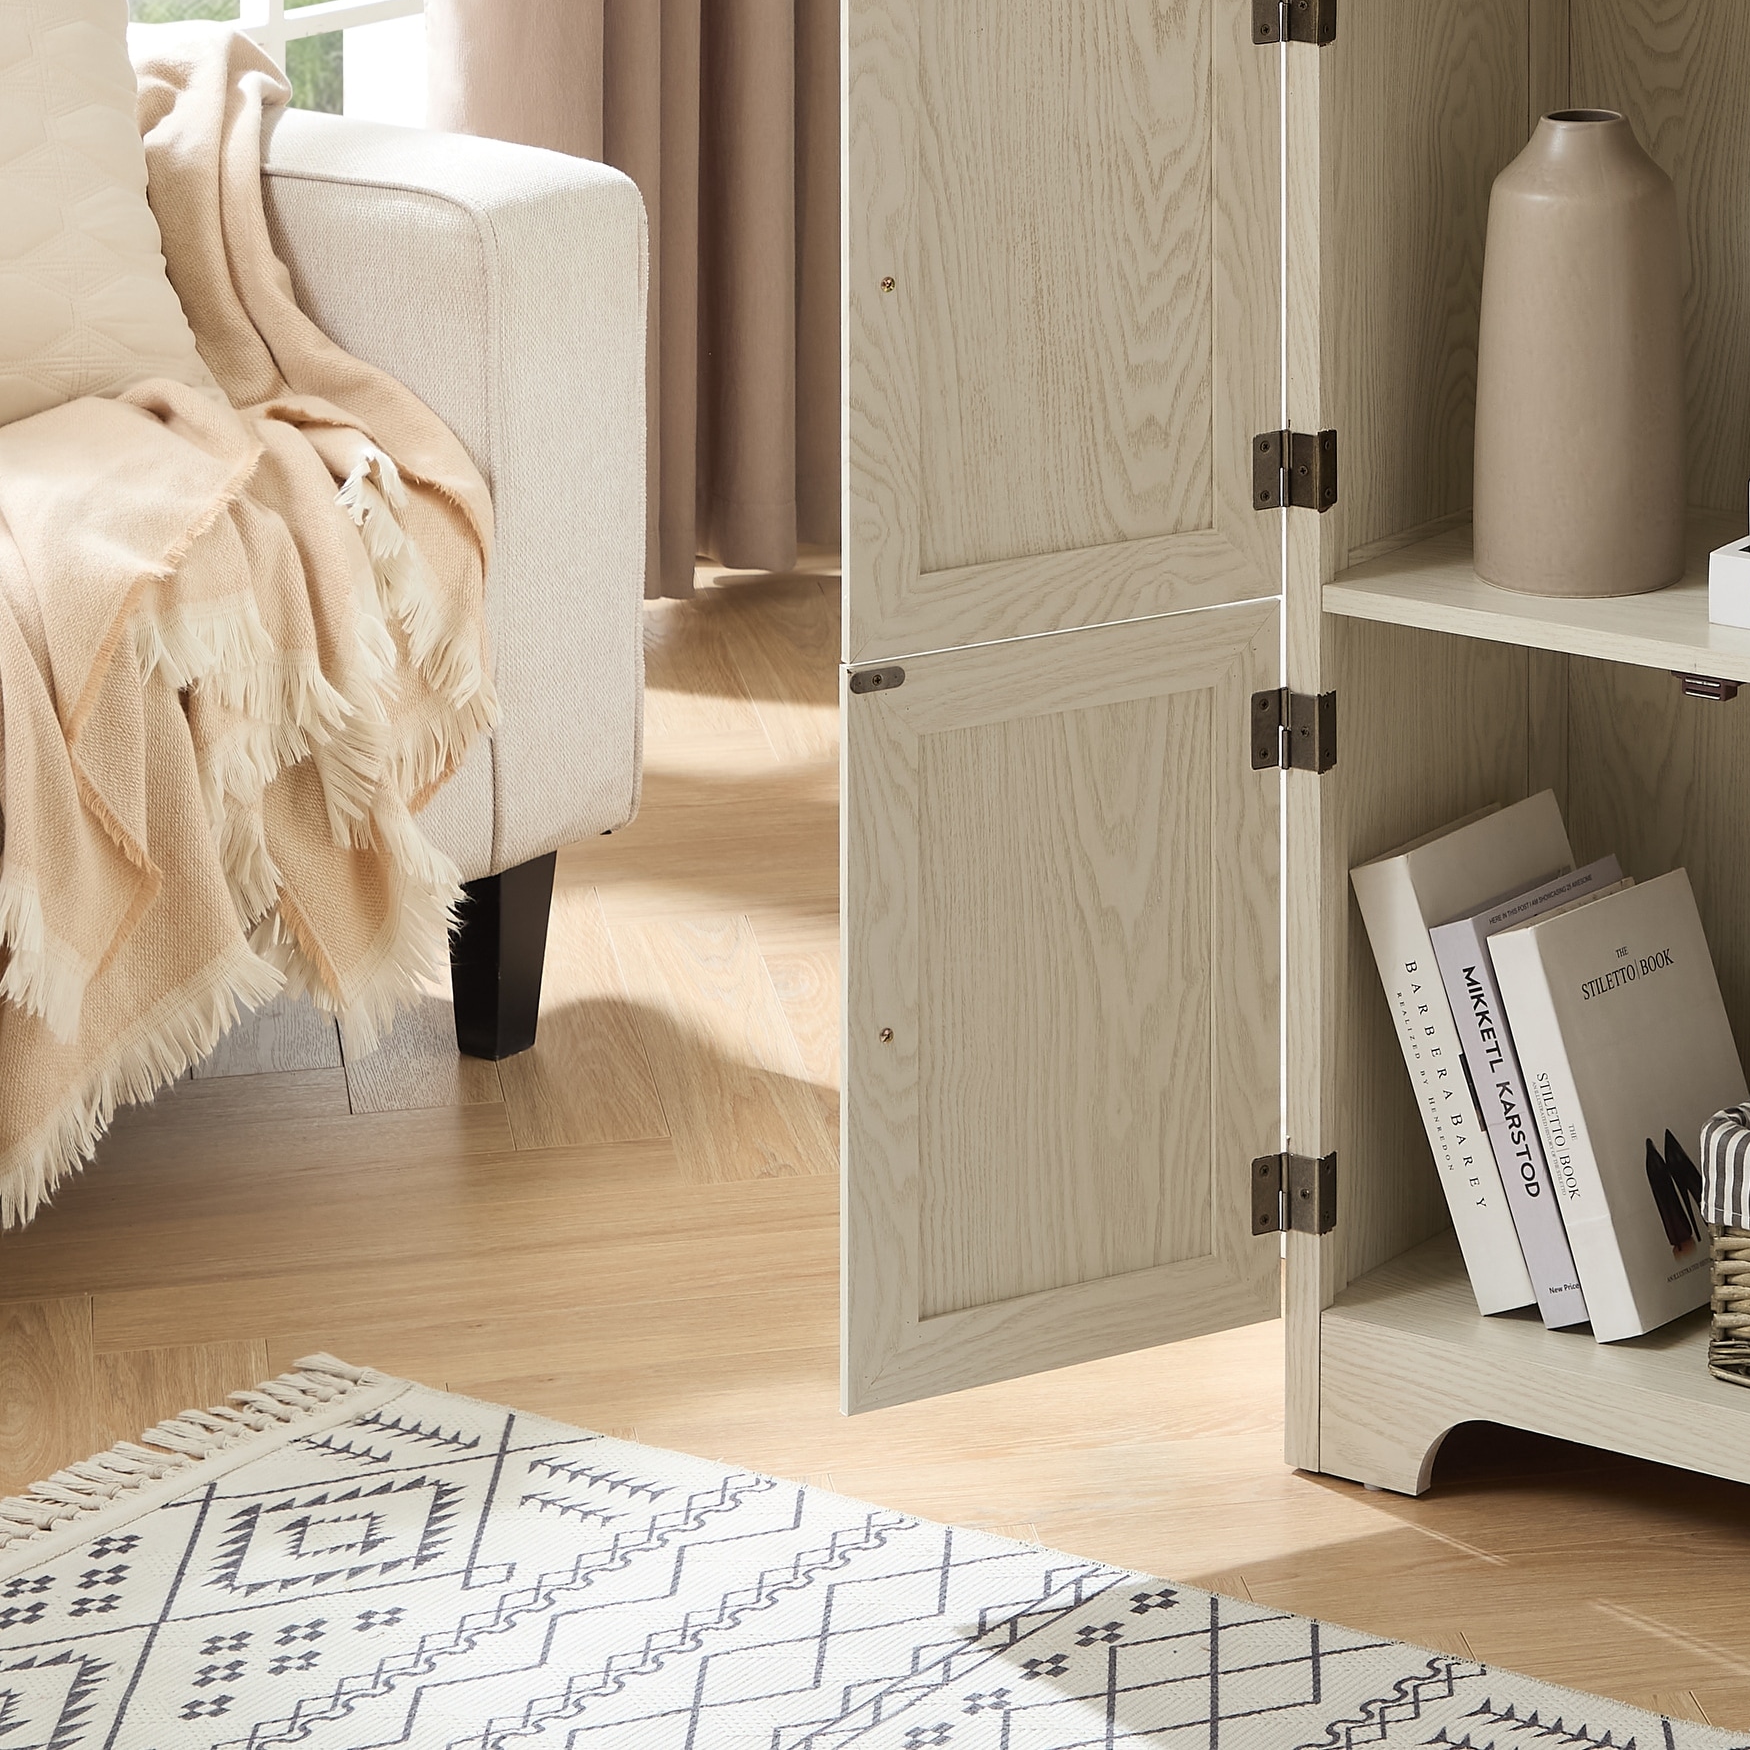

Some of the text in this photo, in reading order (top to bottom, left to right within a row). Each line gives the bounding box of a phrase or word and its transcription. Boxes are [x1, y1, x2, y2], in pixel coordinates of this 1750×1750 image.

[1489, 914, 1502, 925] HERE
[1581, 948, 1674, 1000] STILETTO BOOK
[1615, 946, 1629, 959] THE
[1397, 991, 1421, 1060] REALIZED
[1420, 1070, 1429, 1085] BY
[1404, 960, 1487, 1208] BARBERA BAREY
[1462, 965, 1541, 1198] MIKKETL KARSTOD
[1536, 1072, 1581, 1201] STILETTO BOOK
[1568, 1123, 1578, 1141] THE
[1548, 1283, 1580, 1295] New Price
